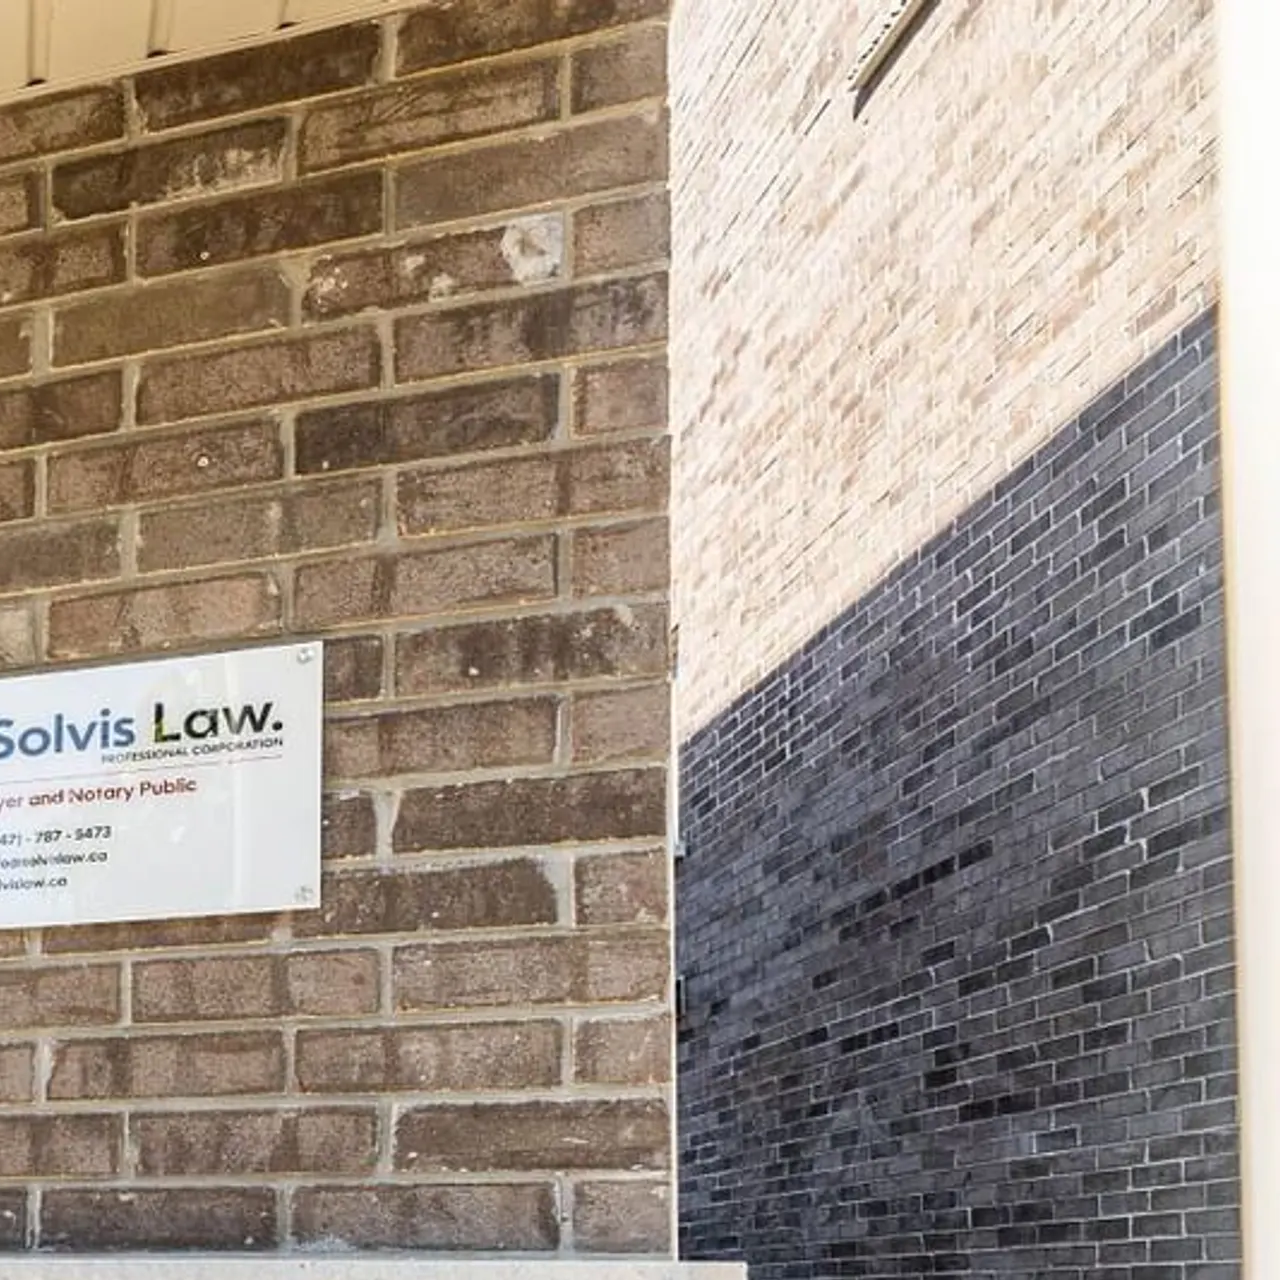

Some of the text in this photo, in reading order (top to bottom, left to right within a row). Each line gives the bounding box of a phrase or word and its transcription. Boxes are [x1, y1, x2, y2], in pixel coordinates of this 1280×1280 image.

[154, 701, 283, 743] Law.
[101, 737, 284, 764] PROFESSIONAL CORPORATION
[29, 788, 64, 806] and
[68, 784, 134, 803] Notary
[139, 777, 198, 797] Public
[34, 830, 62, 844] 787
